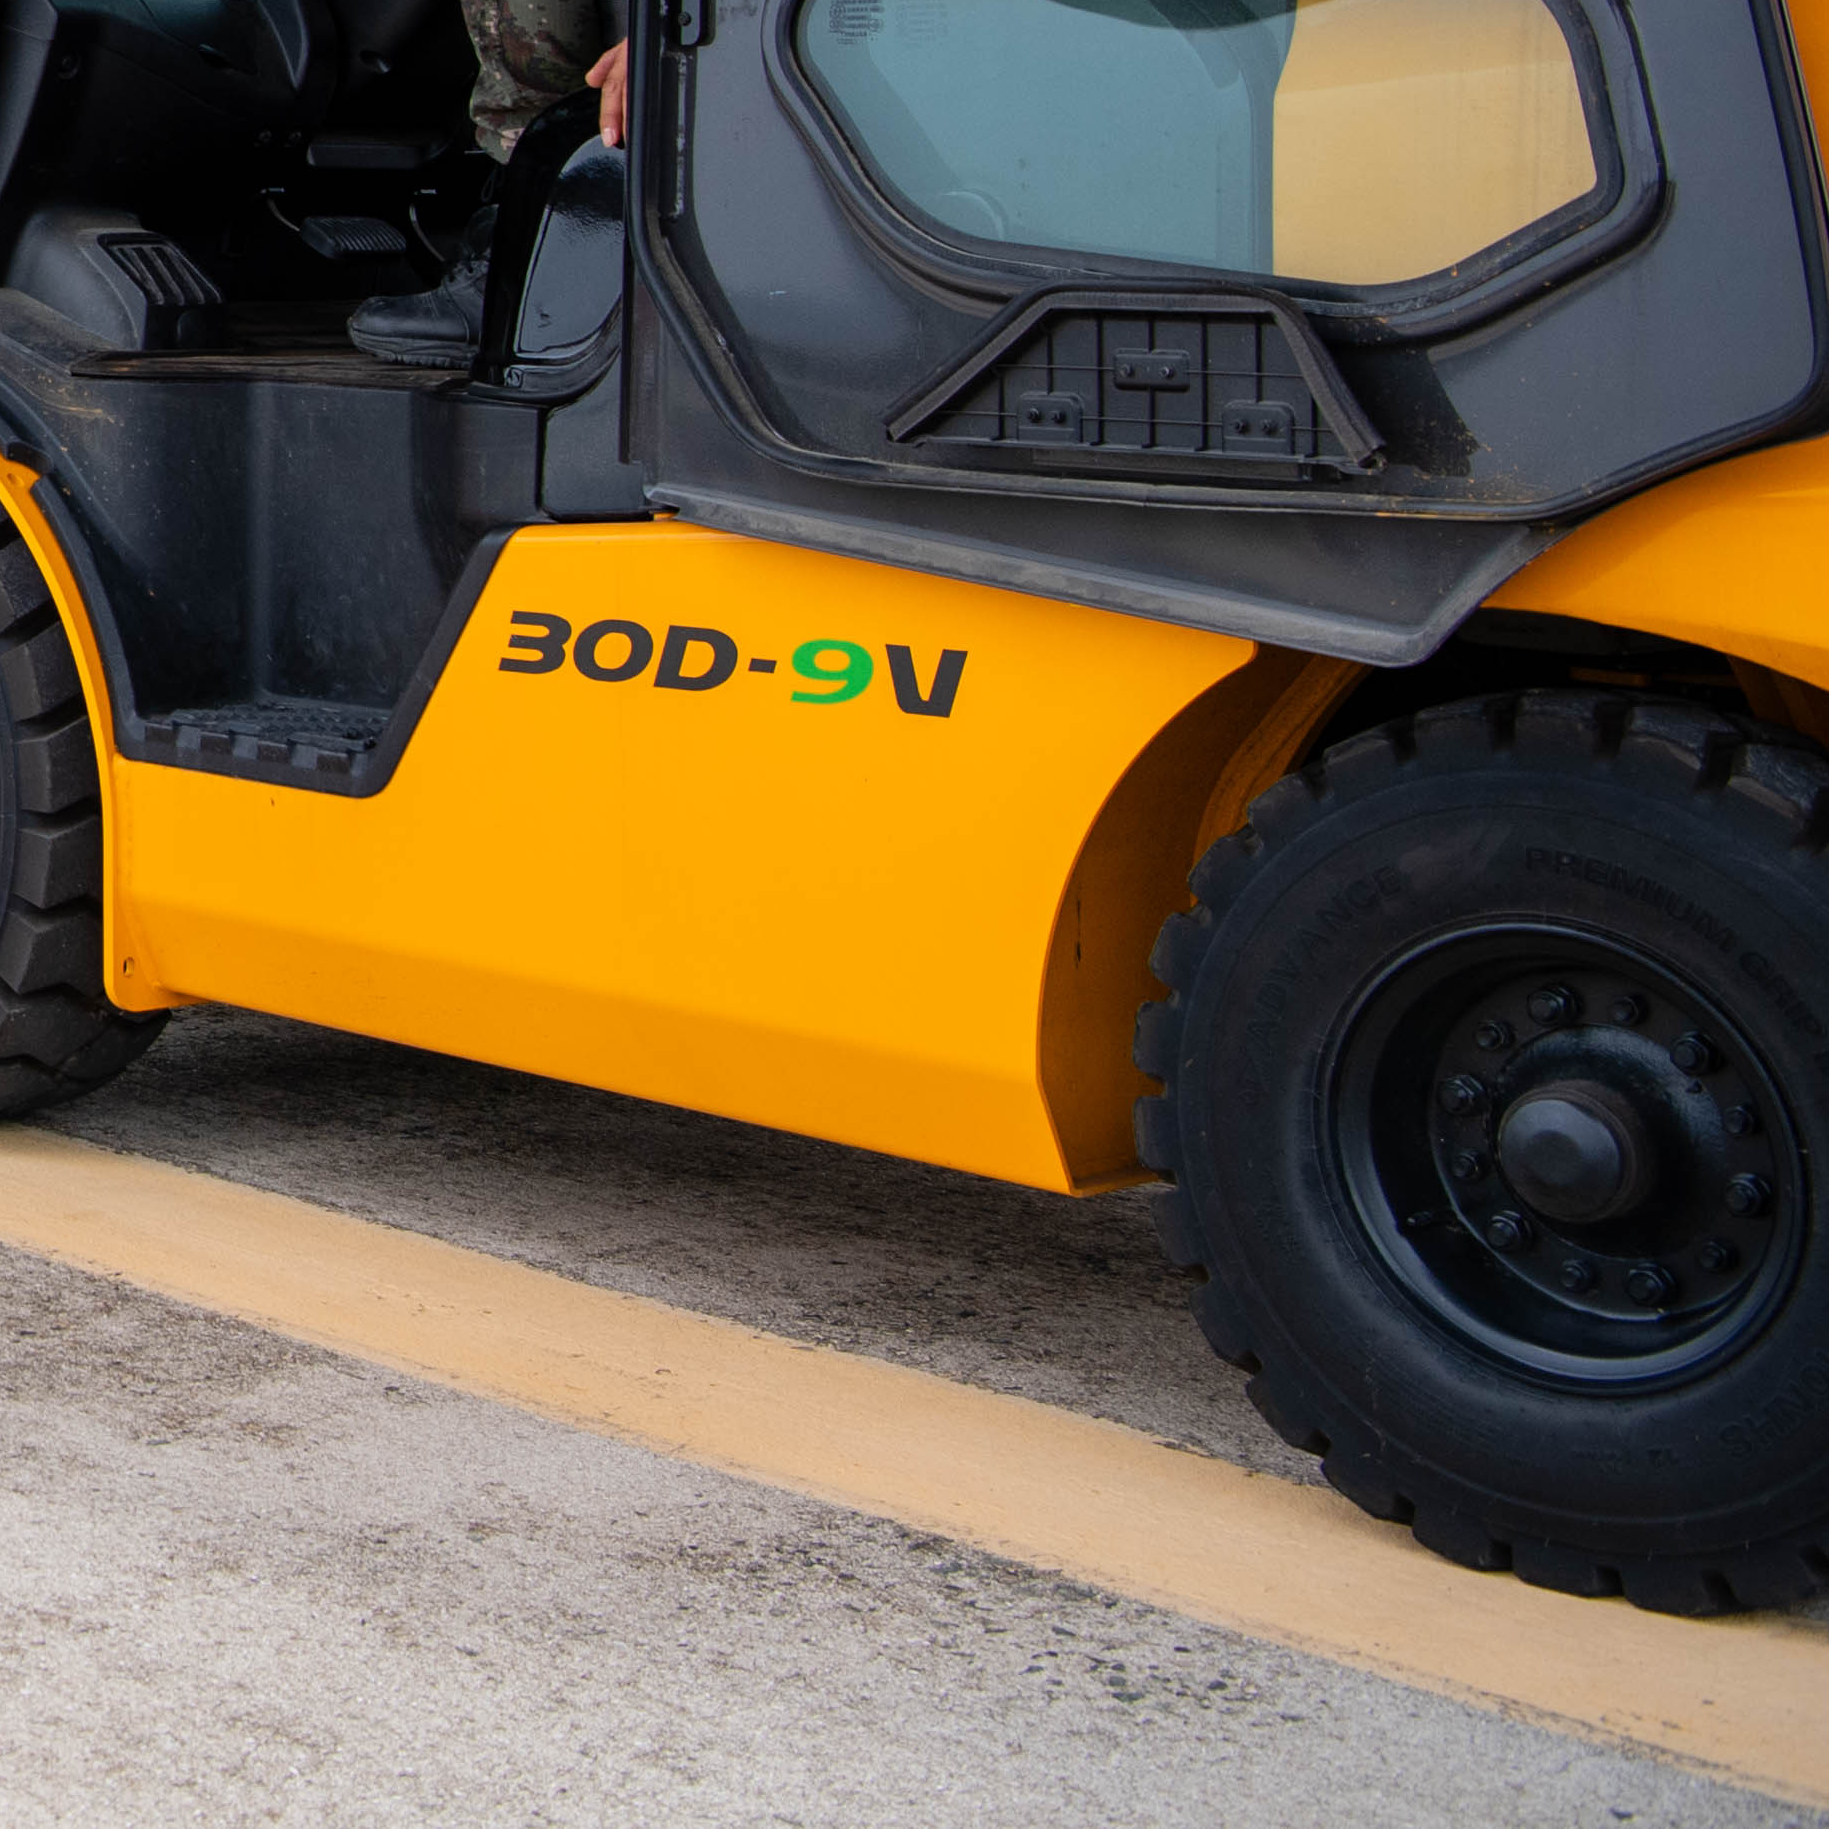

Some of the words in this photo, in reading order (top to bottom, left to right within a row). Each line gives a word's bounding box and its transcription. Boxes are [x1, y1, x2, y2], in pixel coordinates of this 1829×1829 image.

[498, 610, 968, 718] 30D-9V
[1525, 847, 1738, 954] PREMIUM
[1246, 865, 1403, 1054] ADVANCE
